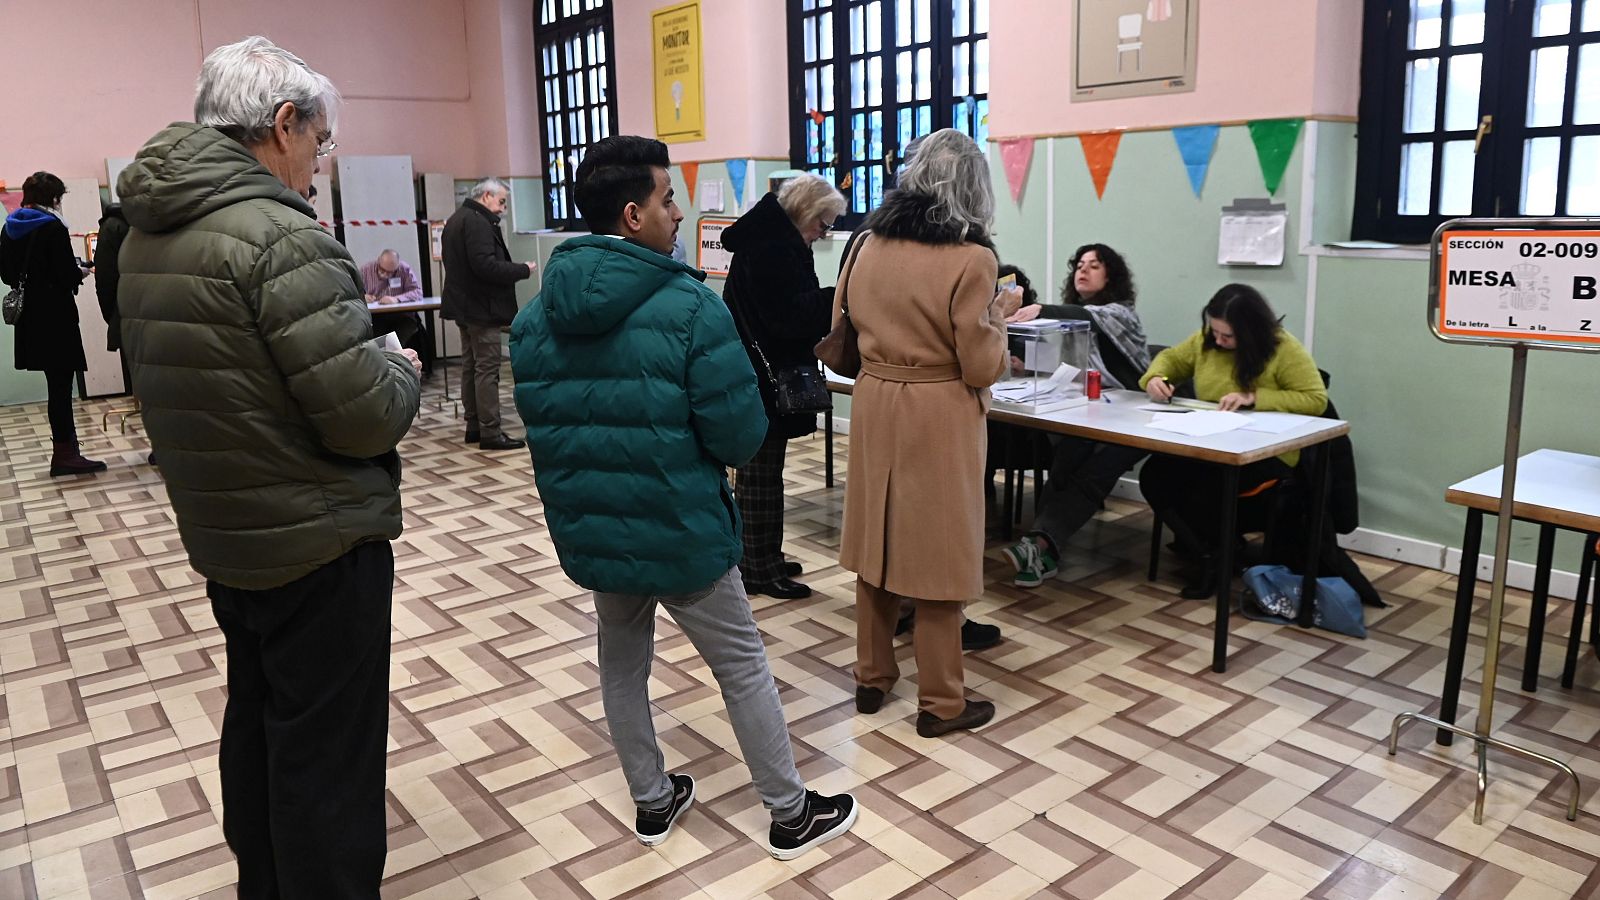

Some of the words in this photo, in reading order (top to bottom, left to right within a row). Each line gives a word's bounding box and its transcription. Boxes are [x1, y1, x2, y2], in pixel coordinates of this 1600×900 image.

[702, 240, 724, 250] MES
[1449, 239, 1504, 249] SECCIÓN
[1519, 242, 1598, 258] 02-009
[1449, 270, 1516, 287] MESA
[1572, 276, 1597, 300] B
[1508, 316, 1517, 327] L
[1538, 323, 1547, 331] la
[1580, 319, 1592, 331] Z
